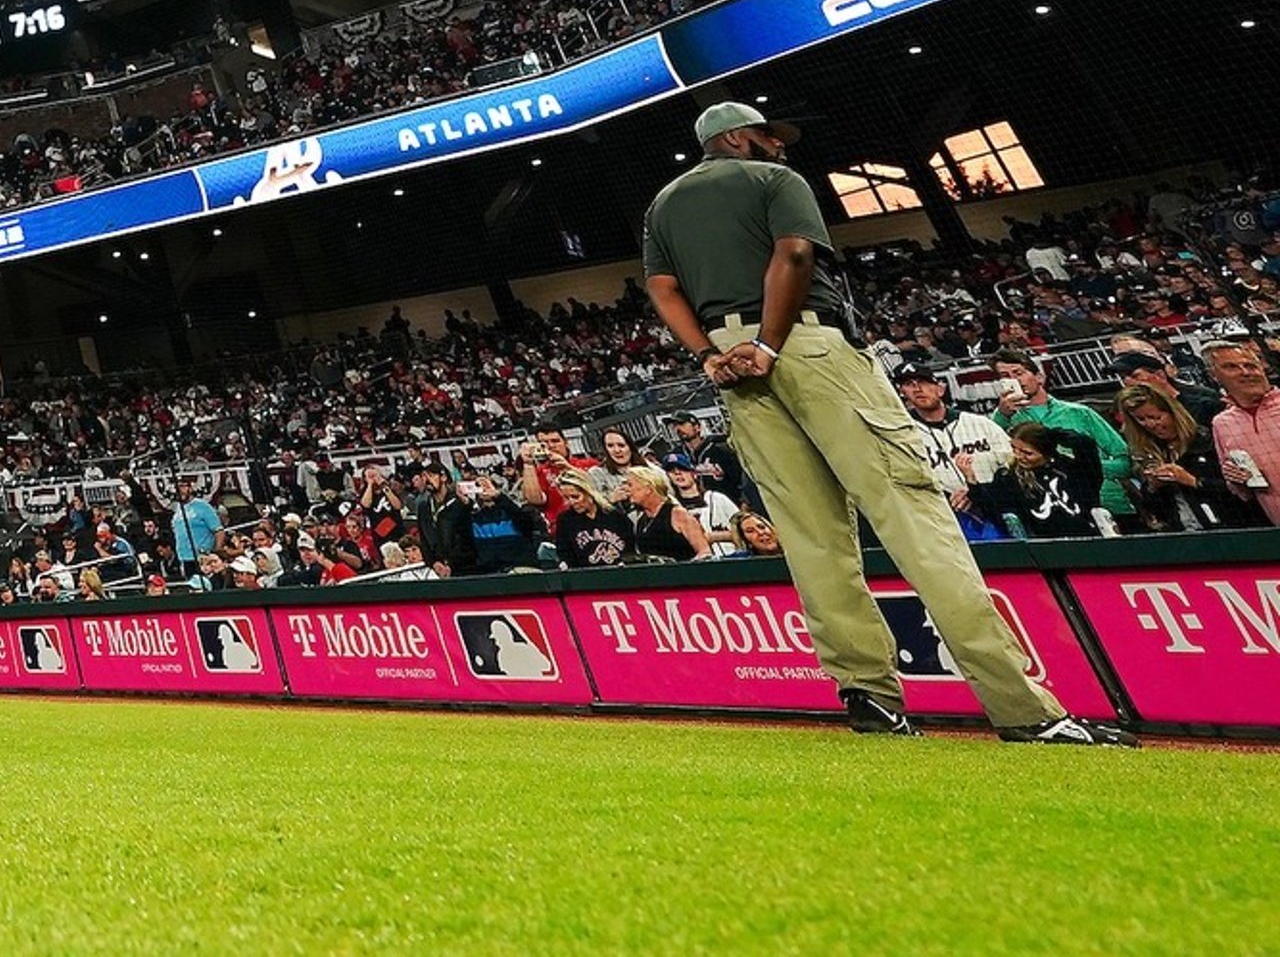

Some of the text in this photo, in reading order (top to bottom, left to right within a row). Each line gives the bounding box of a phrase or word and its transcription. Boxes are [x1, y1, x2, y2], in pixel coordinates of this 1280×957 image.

[9, 6, 65, 38] 7:16
[397, 94, 564, 151] ATLANTA
[103, 619, 178, 656] Mobile
[318, 611, 429, 659] Mobile
[638, 595, 816, 655] Mobile
